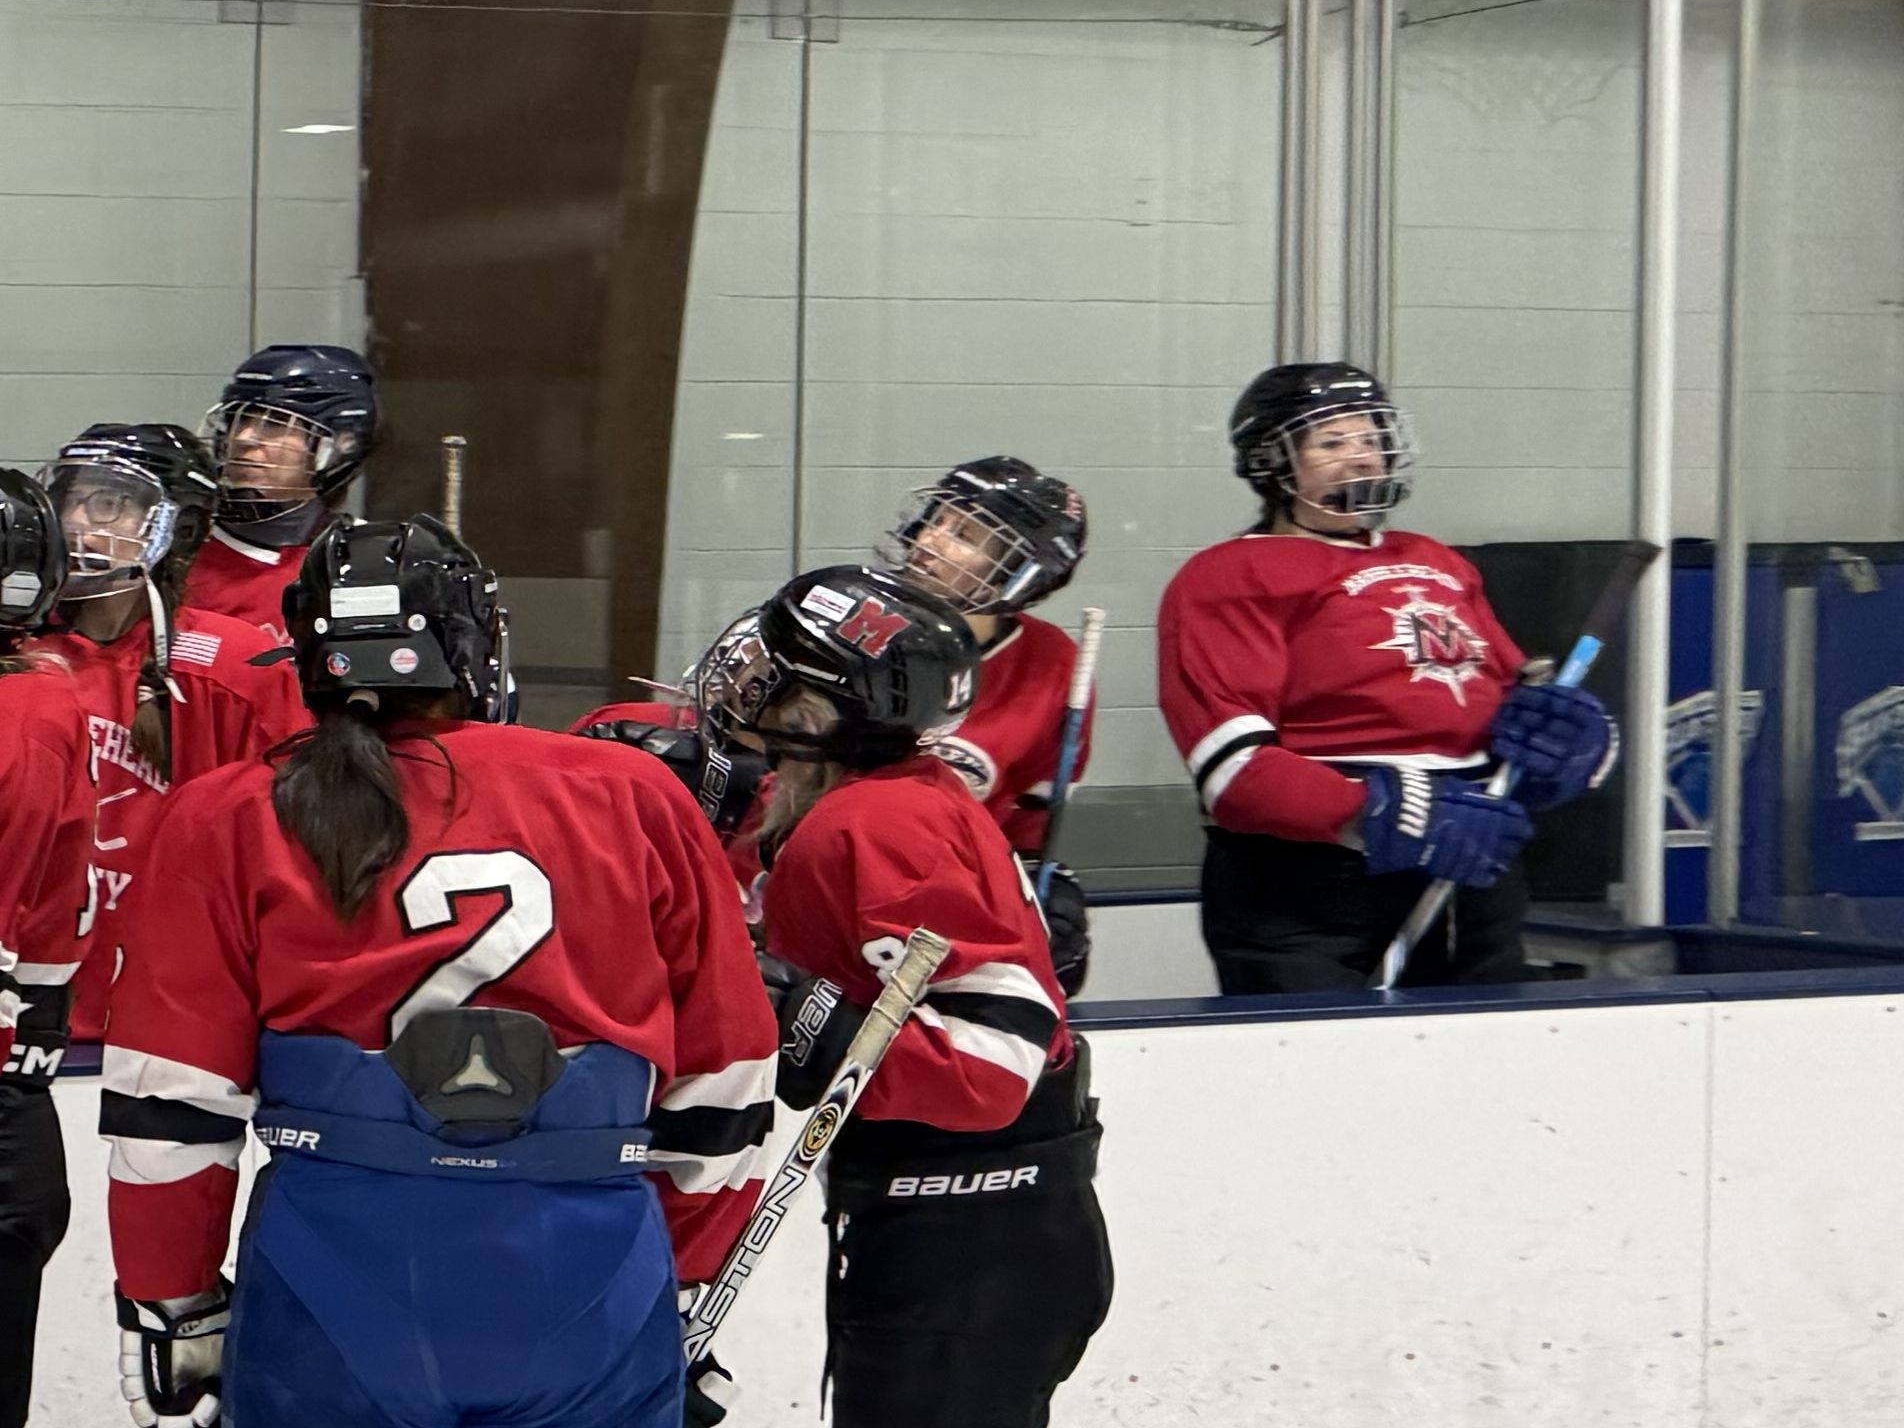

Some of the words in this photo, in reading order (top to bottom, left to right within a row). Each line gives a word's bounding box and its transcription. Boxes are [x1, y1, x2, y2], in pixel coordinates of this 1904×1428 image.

[836, 596, 912, 659] M
[948, 668, 972, 709] 14
[400, 849, 554, 1042] 2
[887, 1165, 1040, 1198] BAUER
[682, 1166, 810, 1362] ASTON
